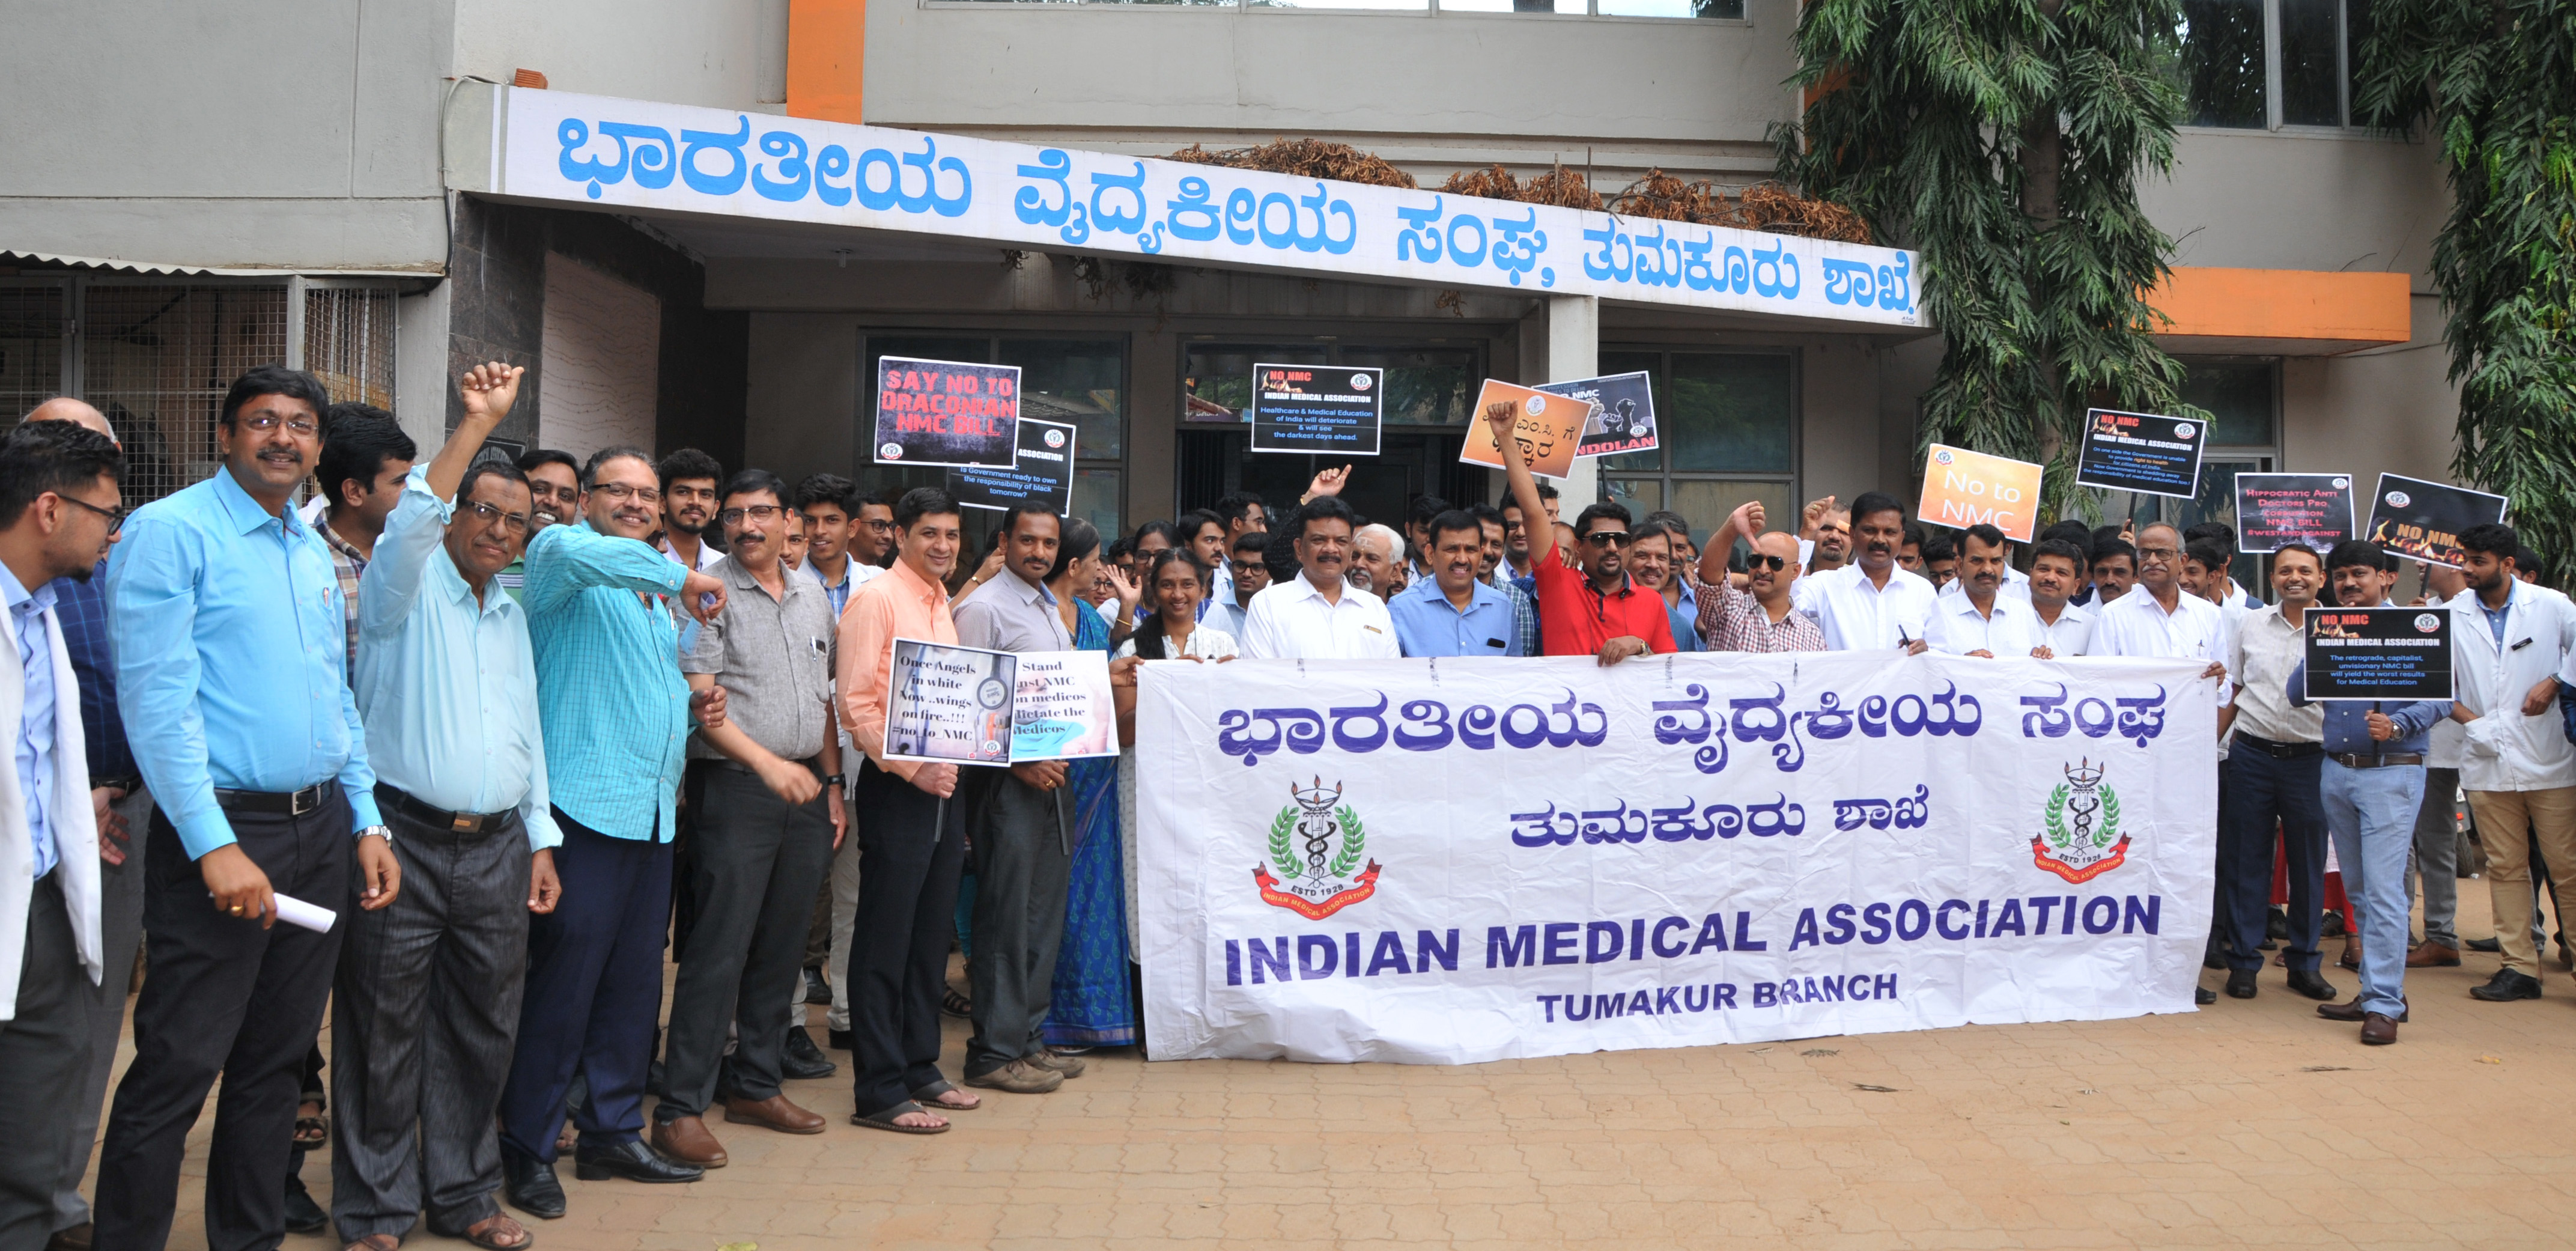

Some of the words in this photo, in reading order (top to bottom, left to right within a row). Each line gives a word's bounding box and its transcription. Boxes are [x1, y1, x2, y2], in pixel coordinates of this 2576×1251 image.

[557, 115, 972, 218] ಭಾರತೀಯ
[1015, 149, 1356, 255] ವೈದ್ಯಕೀಯ
[1584, 218, 1800, 300] ತುಮಕೂರು
[1270, 371, 1284, 380] NO
[1287, 371, 1312, 382] NMC
[886, 370, 938, 391] SAY
[946, 375, 979, 394] NO
[986, 378, 1012, 397] TO
[1291, 393, 1322, 401] MEDICAL
[1323, 394, 1371, 403] ASSOCIATION
[1572, 389, 1600, 399] NMC
[881, 391, 1016, 418] DRACONIAN
[896, 413, 947, 433] NMC
[953, 416, 1001, 436] BILL
[2101, 415, 2115, 424] NO
[2116, 416, 2140, 427] NMC
[1563, 426, 1576, 440] ಗೆ
[2094, 433, 2116, 442] INDIAN
[2118, 436, 2146, 446] MEDICAL
[2147, 440, 2193, 451] ASSOCIATION
[1018, 448, 1063, 461] ASSOCIATION
[968, 467, 1010, 479] Government
[1012, 473, 1031, 482] ready
[2092, 469, 2125, 478] responsibility
[977, 478, 1022, 490] responsibility
[1033, 484, 1052, 493] black
[1944, 470, 1985, 495] No
[1994, 482, 2020, 503] to
[989, 488, 1027, 498] tomorrow?
[2246, 489, 2310, 498] HIPPOCRATIC
[1942, 499, 2014, 531] NMC
[2298, 519, 2322, 527] BILL
[2396, 523, 2422, 540] NO
[2321, 615, 2338, 625] NO
[2341, 615, 2369, 625] NMC
[2316, 638, 2345, 647] INDIAN
[901, 656, 933, 669] Once
[934, 661, 976, 675] Angels
[1022, 661, 1062, 671] Stand
[911, 675, 923, 685] in
[927, 677, 962, 690] white
[1044, 676, 1075, 686] NMC
[899, 690, 926, 702] Now
[1032, 692, 1086, 702] medicos
[902, 710, 917, 719] on
[1064, 707, 1086, 717] the
[1218, 689, 1608, 767] ಭಾರತೀಯ
[1652, 678, 1982, 775] ವೈದ್ಯಕೀಯ
[2020, 682, 2166, 749] ಸಂಘ
[1510, 791, 1806, 847] ತುಮಕೂರು
[1832, 784, 1929, 831] ಶಾಖೆ
[2058, 853, 2079, 863] ESTD
[2036, 859, 2055, 868] INDIAN
[2057, 864, 2080, 881] MEDICAL
[2081, 857, 2121, 880] ASSOCIATION
[1290, 884, 1317, 896] ESTD
[1321, 884, 1344, 896] 1928
[1263, 892, 1289, 903] INDIAN
[1290, 899, 1320, 917] MEDICAL
[1322, 887, 1370, 915] ASSOCIATION
[1225, 928, 1459, 986] INDIAN
[1486, 911, 1767, 969] MEDICAL
[1788, 895, 2161, 952] ASSOCIATION
[1537, 983, 1737, 1023] TUMAKUR
[1754, 973, 1897, 1008] BRANCH
